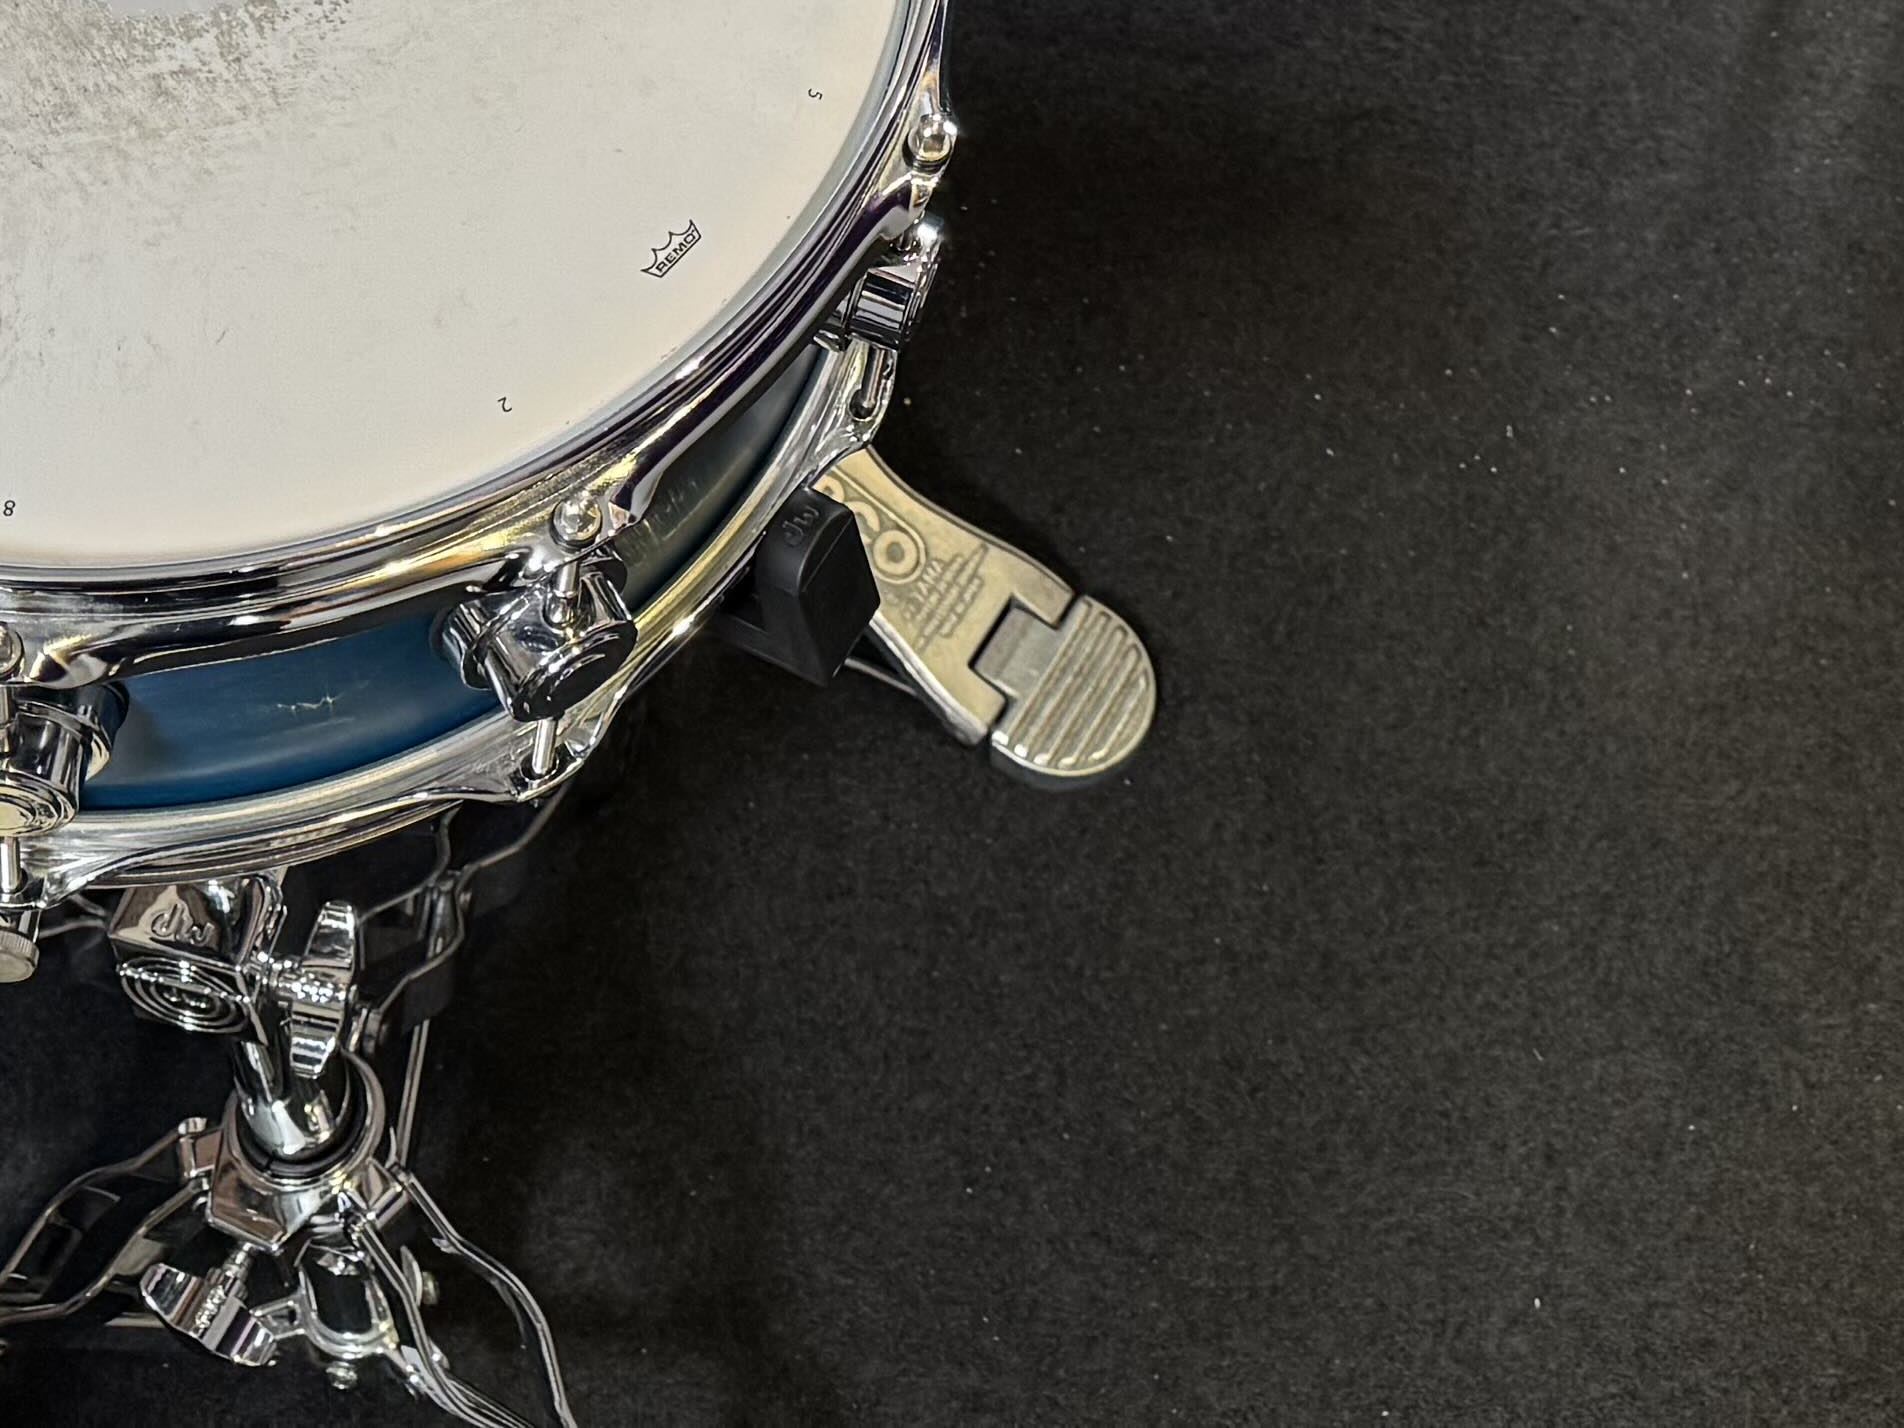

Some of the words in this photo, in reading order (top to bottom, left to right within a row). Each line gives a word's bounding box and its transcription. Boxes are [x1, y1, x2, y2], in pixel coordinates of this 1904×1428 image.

[807, 88, 823, 100] 5
[497, 396, 513, 413] 2
[2, 499, 16, 517] 8
